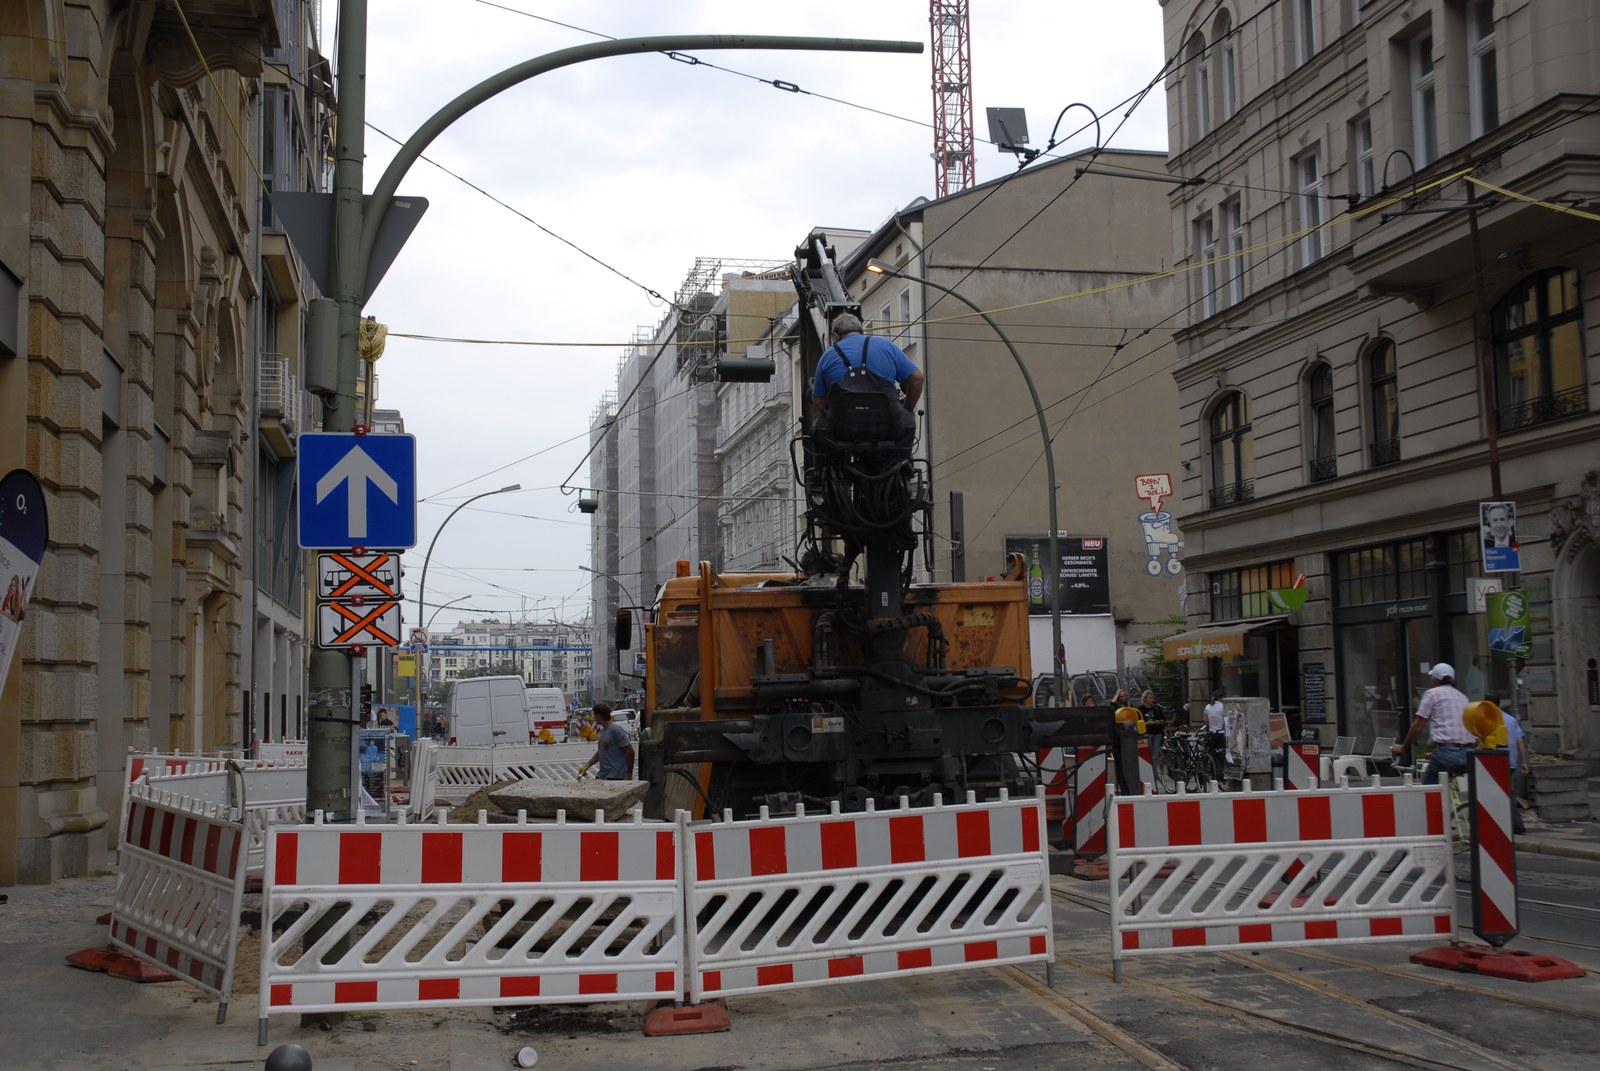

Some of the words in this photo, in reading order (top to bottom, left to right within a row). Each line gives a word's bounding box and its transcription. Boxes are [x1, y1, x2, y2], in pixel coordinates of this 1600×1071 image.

[1140, 478, 1161, 486] BORN
[1144, 487, 1167, 495] ROLL
[1176, 646, 1194, 656] SOPA
[1202, 643, 1230, 654] CABANA
